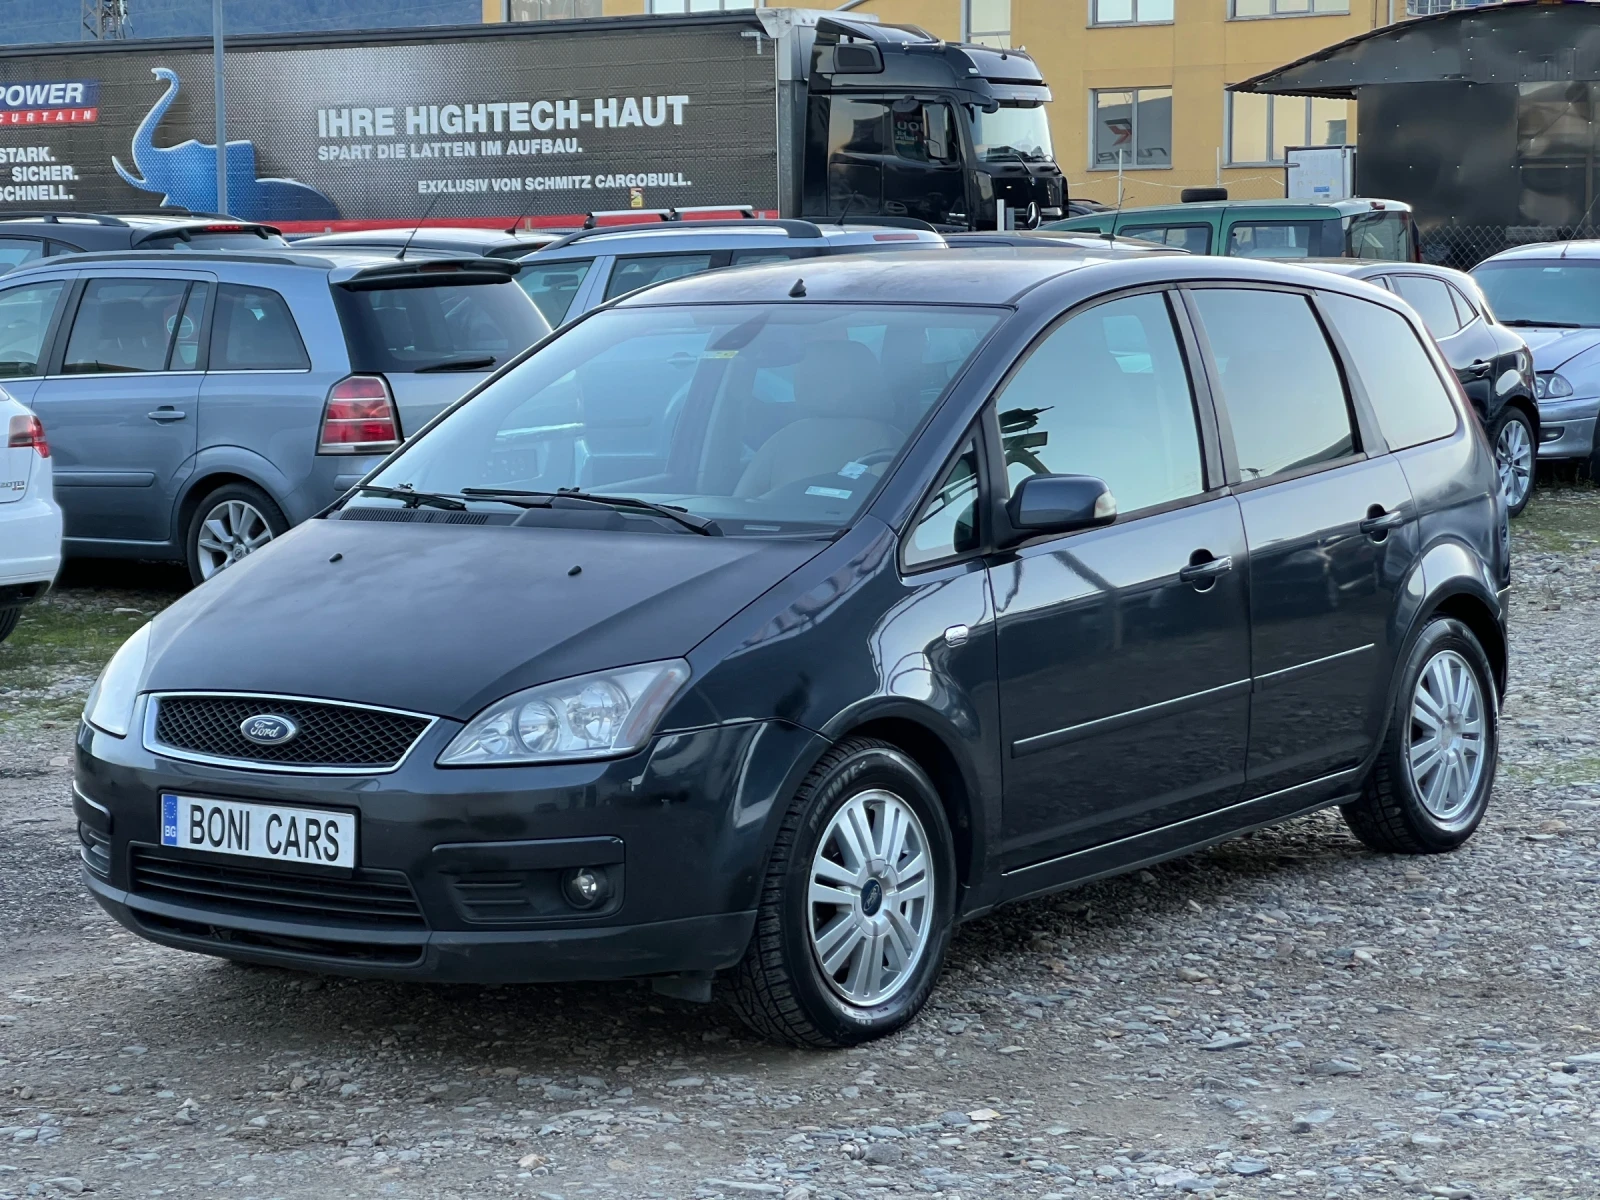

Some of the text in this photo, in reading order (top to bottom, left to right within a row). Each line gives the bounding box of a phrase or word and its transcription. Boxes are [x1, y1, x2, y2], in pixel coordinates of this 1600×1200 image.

[318, 95, 689, 138] IHRE HIGHTECH-HAUT
[0, 147, 55, 163] STARK.
[317, 137, 583, 161] SPART DIE LATTEN IM AUFBAU.
[11, 165, 79, 182] SICHER.
[418, 173, 692, 193] EXKLUSIV VON SCHMITZ CARGOBULL.
[250, 720, 280, 738] Ford
[164, 825, 177, 838] BG
[189, 804, 340, 862] BONI CARS
